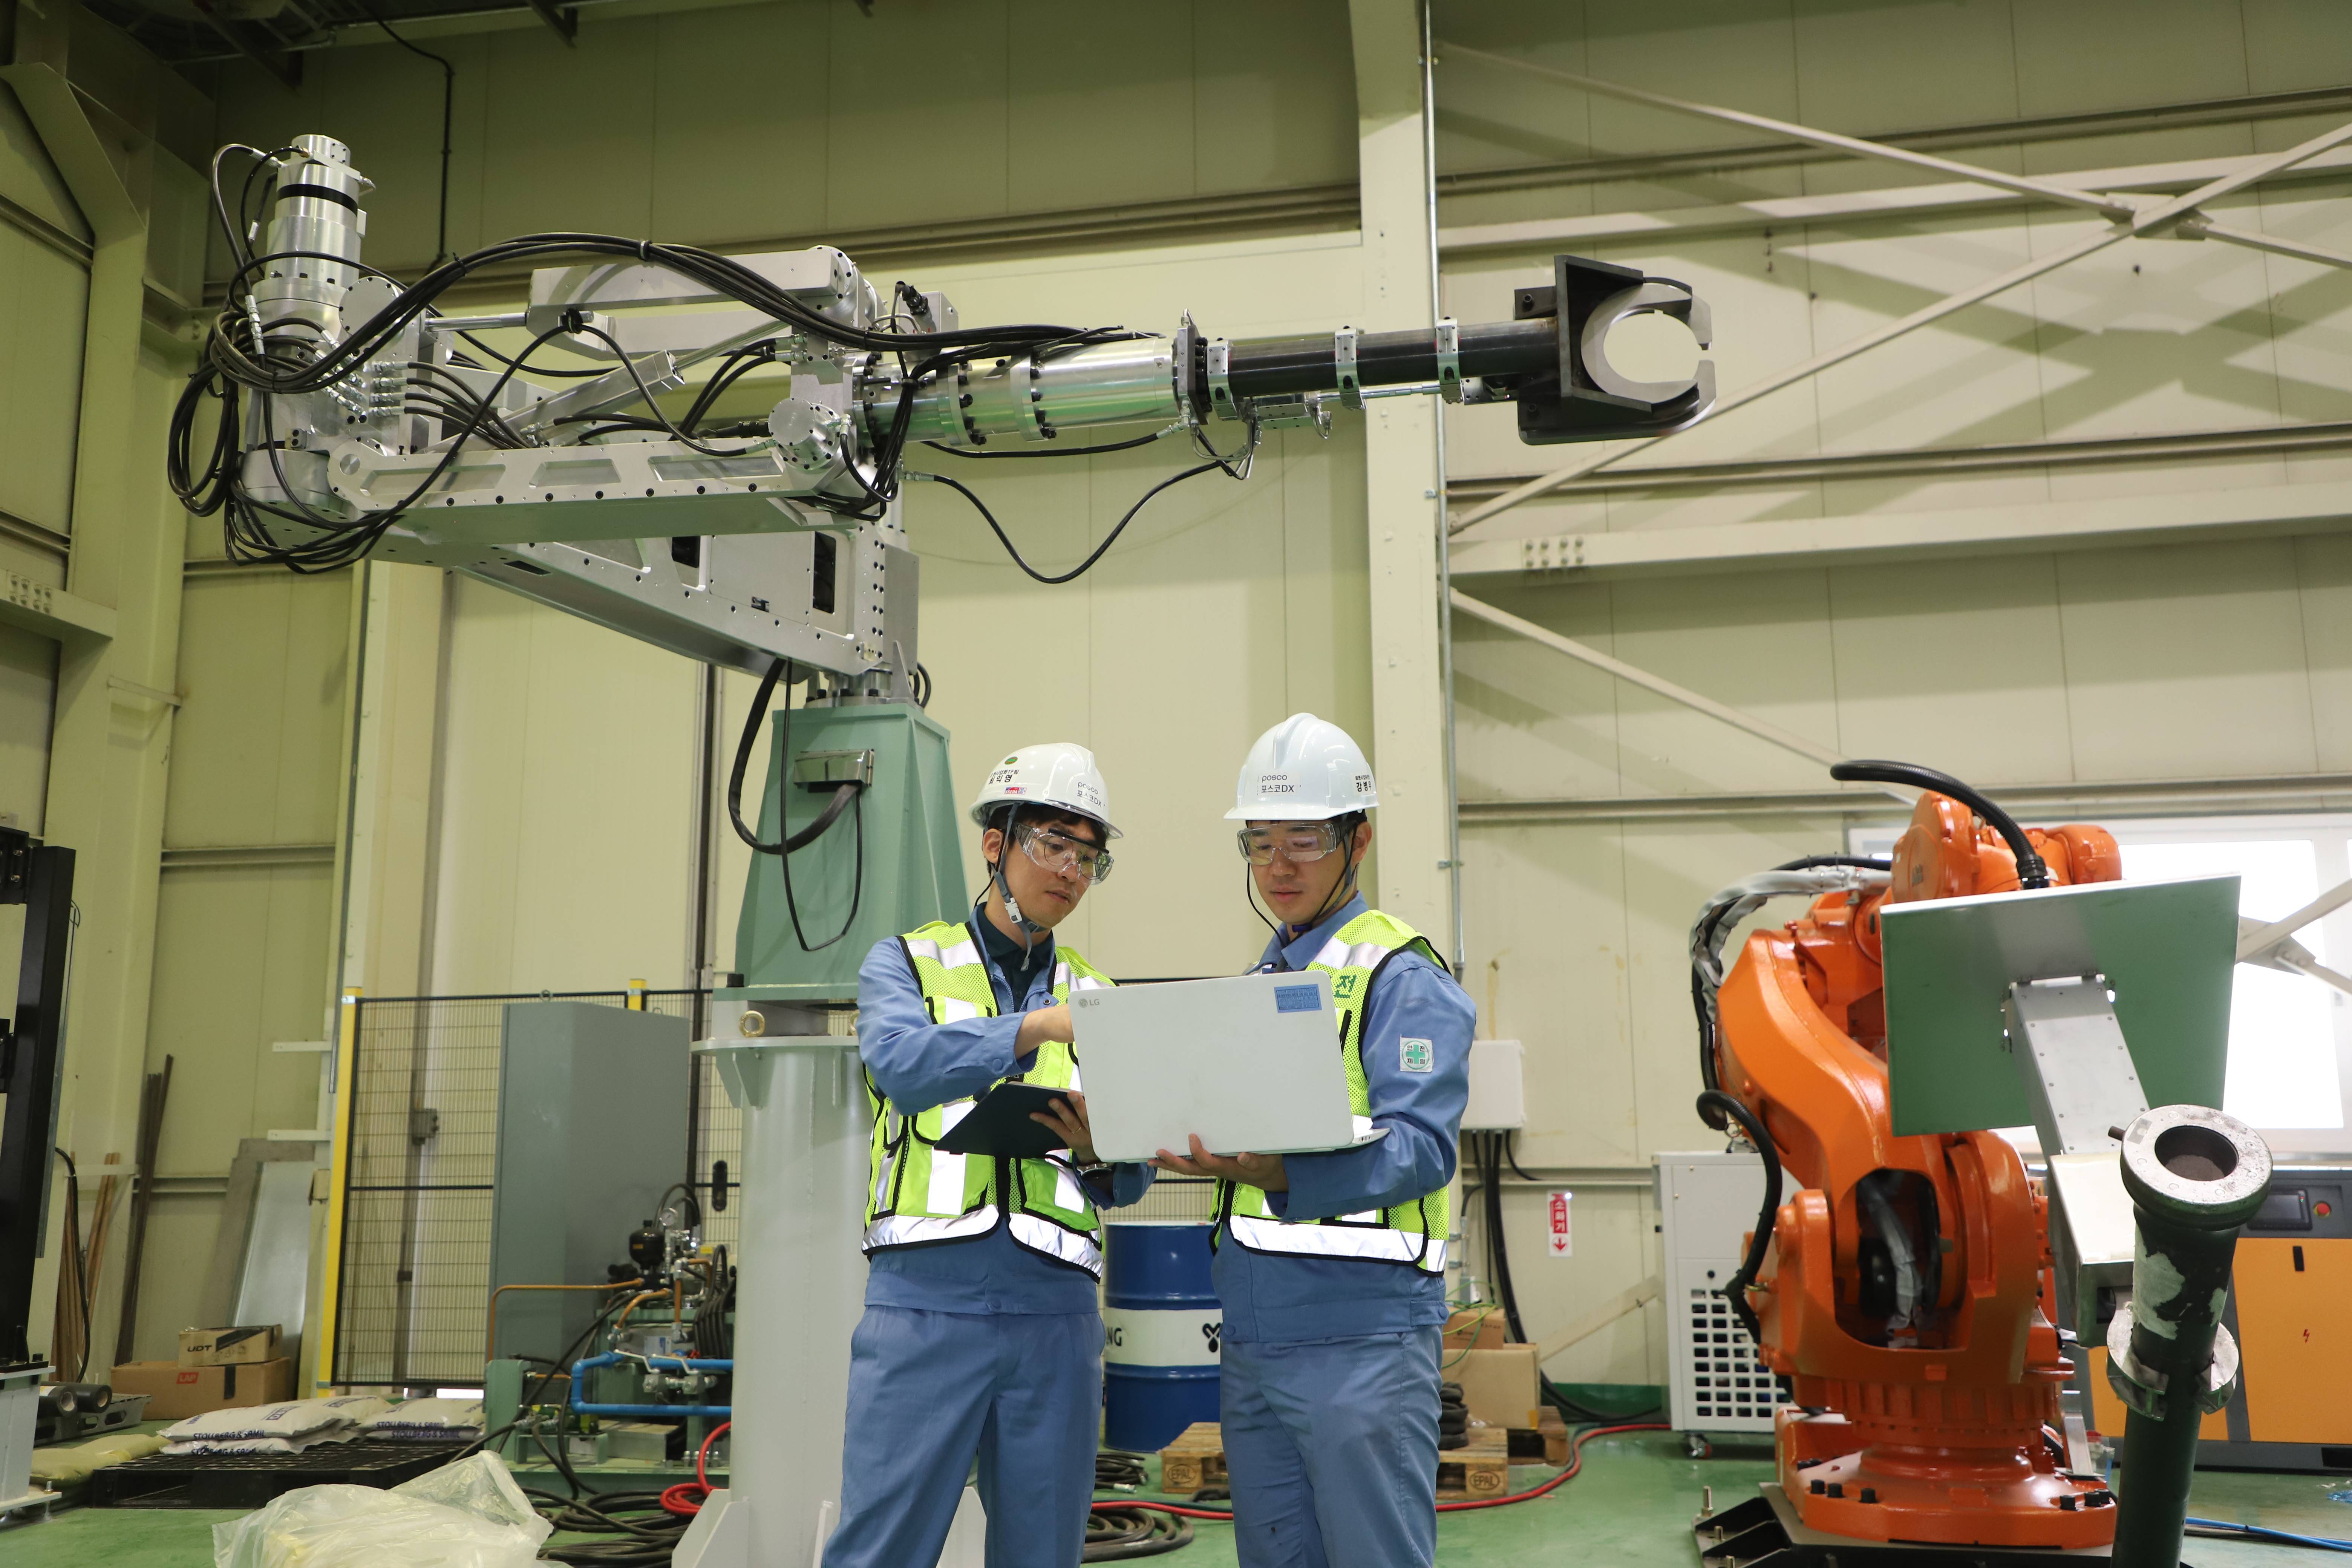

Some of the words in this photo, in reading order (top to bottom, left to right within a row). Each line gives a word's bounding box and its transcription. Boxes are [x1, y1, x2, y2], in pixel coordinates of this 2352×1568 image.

[1262, 775, 1288, 783] posco
[1078, 782, 1098, 795] posco
[1261, 784, 1294, 793] 포스코DX
[1077, 790, 1102, 808] 포스코DX
[1554, 1201, 1566, 1232] 소화기
[244, 1430, 265, 1438] SAMIL
[1171, 1468, 1192, 1479] EPAL
[1474, 1475, 1496, 1486] EPAL
